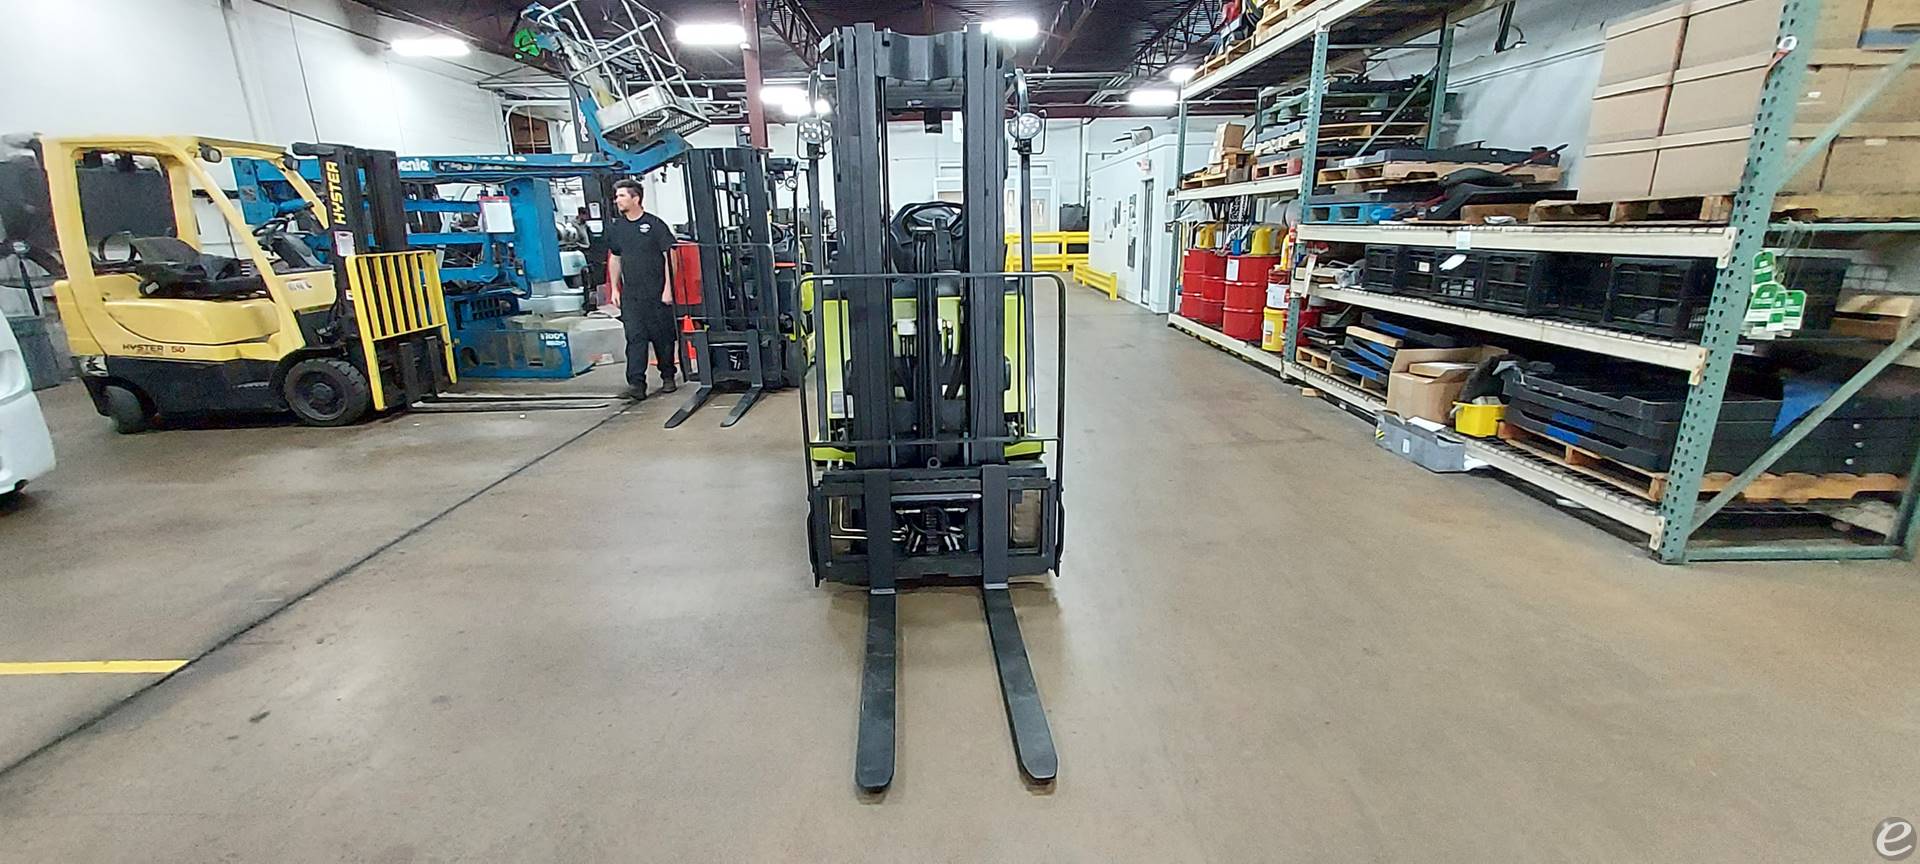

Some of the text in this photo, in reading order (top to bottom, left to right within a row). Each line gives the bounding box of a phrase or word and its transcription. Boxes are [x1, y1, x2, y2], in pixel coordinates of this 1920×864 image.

[398, 157, 430, 172] enie
[325, 161, 347, 225] HYSTER
[123, 344, 164, 352] HYSTER
